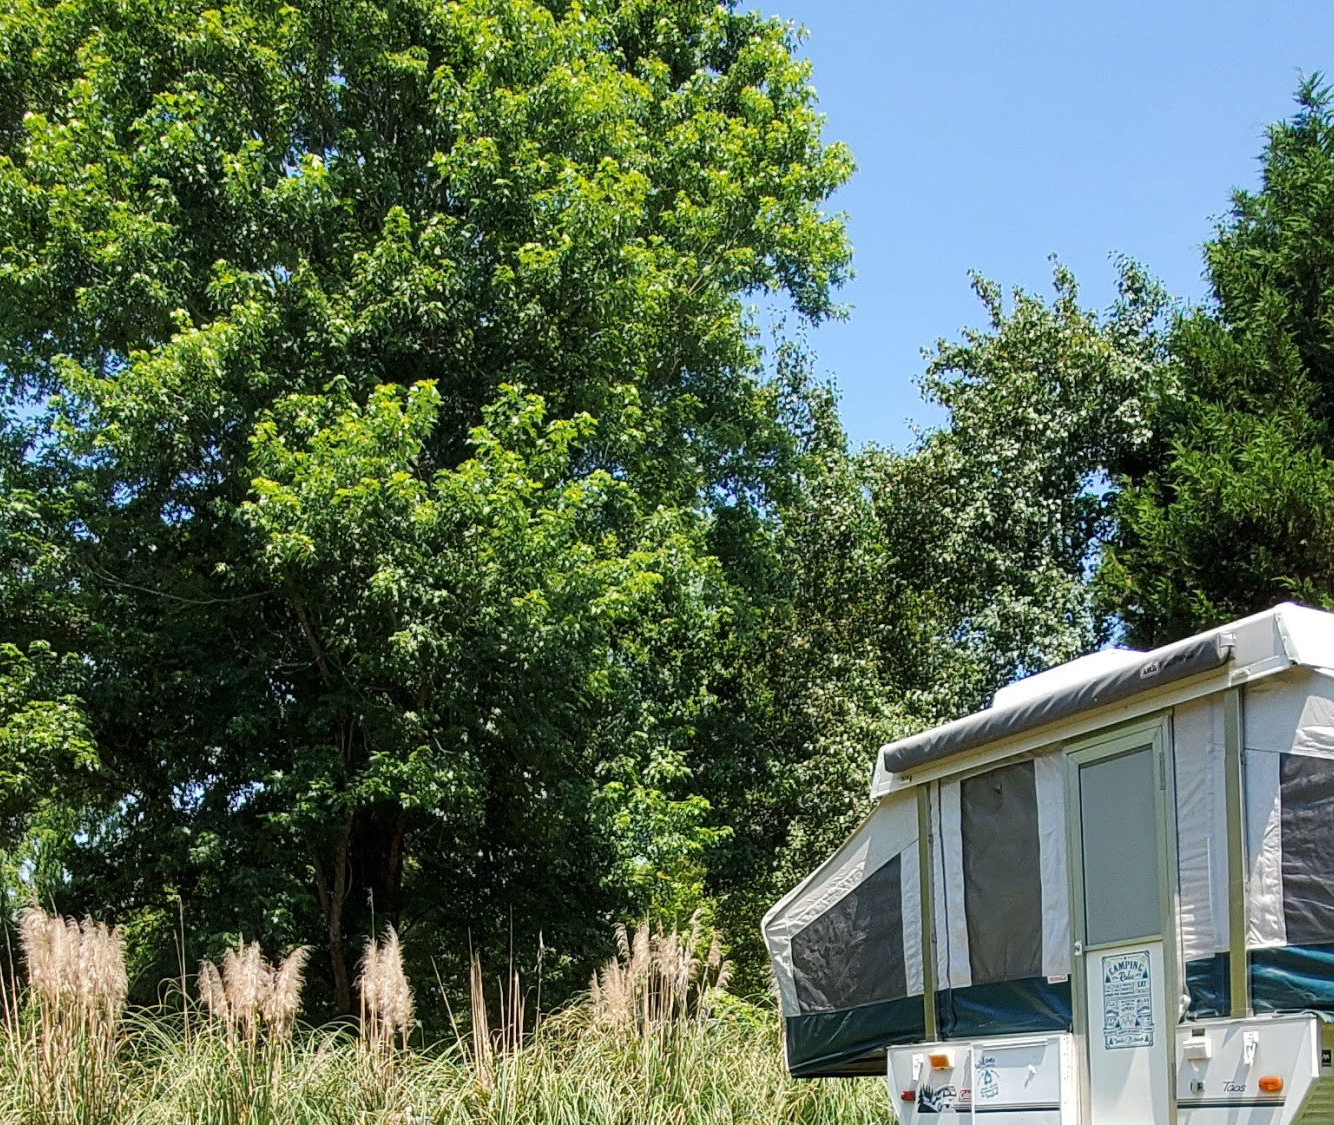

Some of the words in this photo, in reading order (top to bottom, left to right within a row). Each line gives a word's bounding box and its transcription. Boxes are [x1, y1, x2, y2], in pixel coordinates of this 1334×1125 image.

[1108, 961, 1144, 976] CAMPING
[1118, 970, 1134, 982] Rules
[1222, 1081, 1246, 1092] Taos
